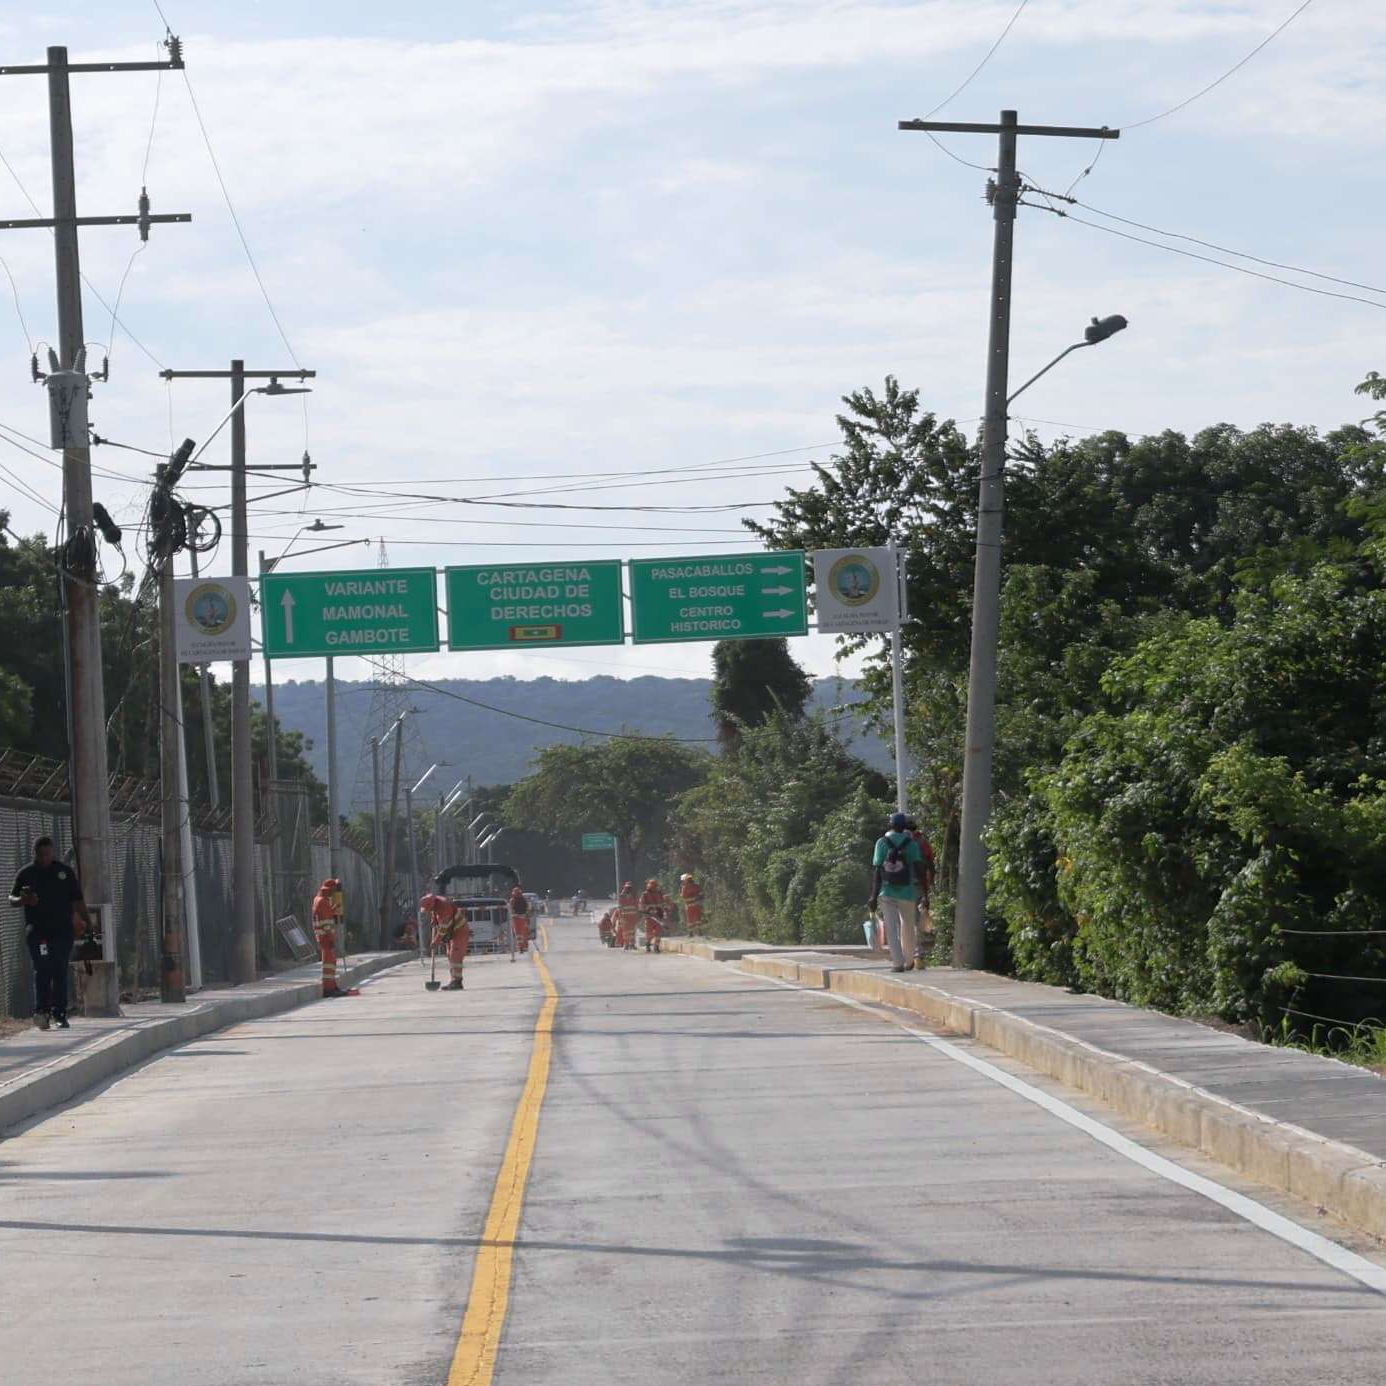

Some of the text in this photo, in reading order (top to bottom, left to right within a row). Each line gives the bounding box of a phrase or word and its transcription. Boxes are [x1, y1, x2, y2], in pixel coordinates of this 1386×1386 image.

[477, 568, 591, 585] CARTAGENA
[651, 563, 753, 580] PASACABALLOS
[324, 580, 408, 596] VARIANTE
[490, 584, 590, 600] CIUDAD DE
[669, 585, 745, 599] EL BOSQUE
[322, 605, 408, 621] MAMONAL
[491, 604, 592, 620] DERECHOS
[679, 605, 733, 618] CENTRO
[670, 619, 741, 632] HISTORICO
[325, 628, 410, 645] GAMBOTE
